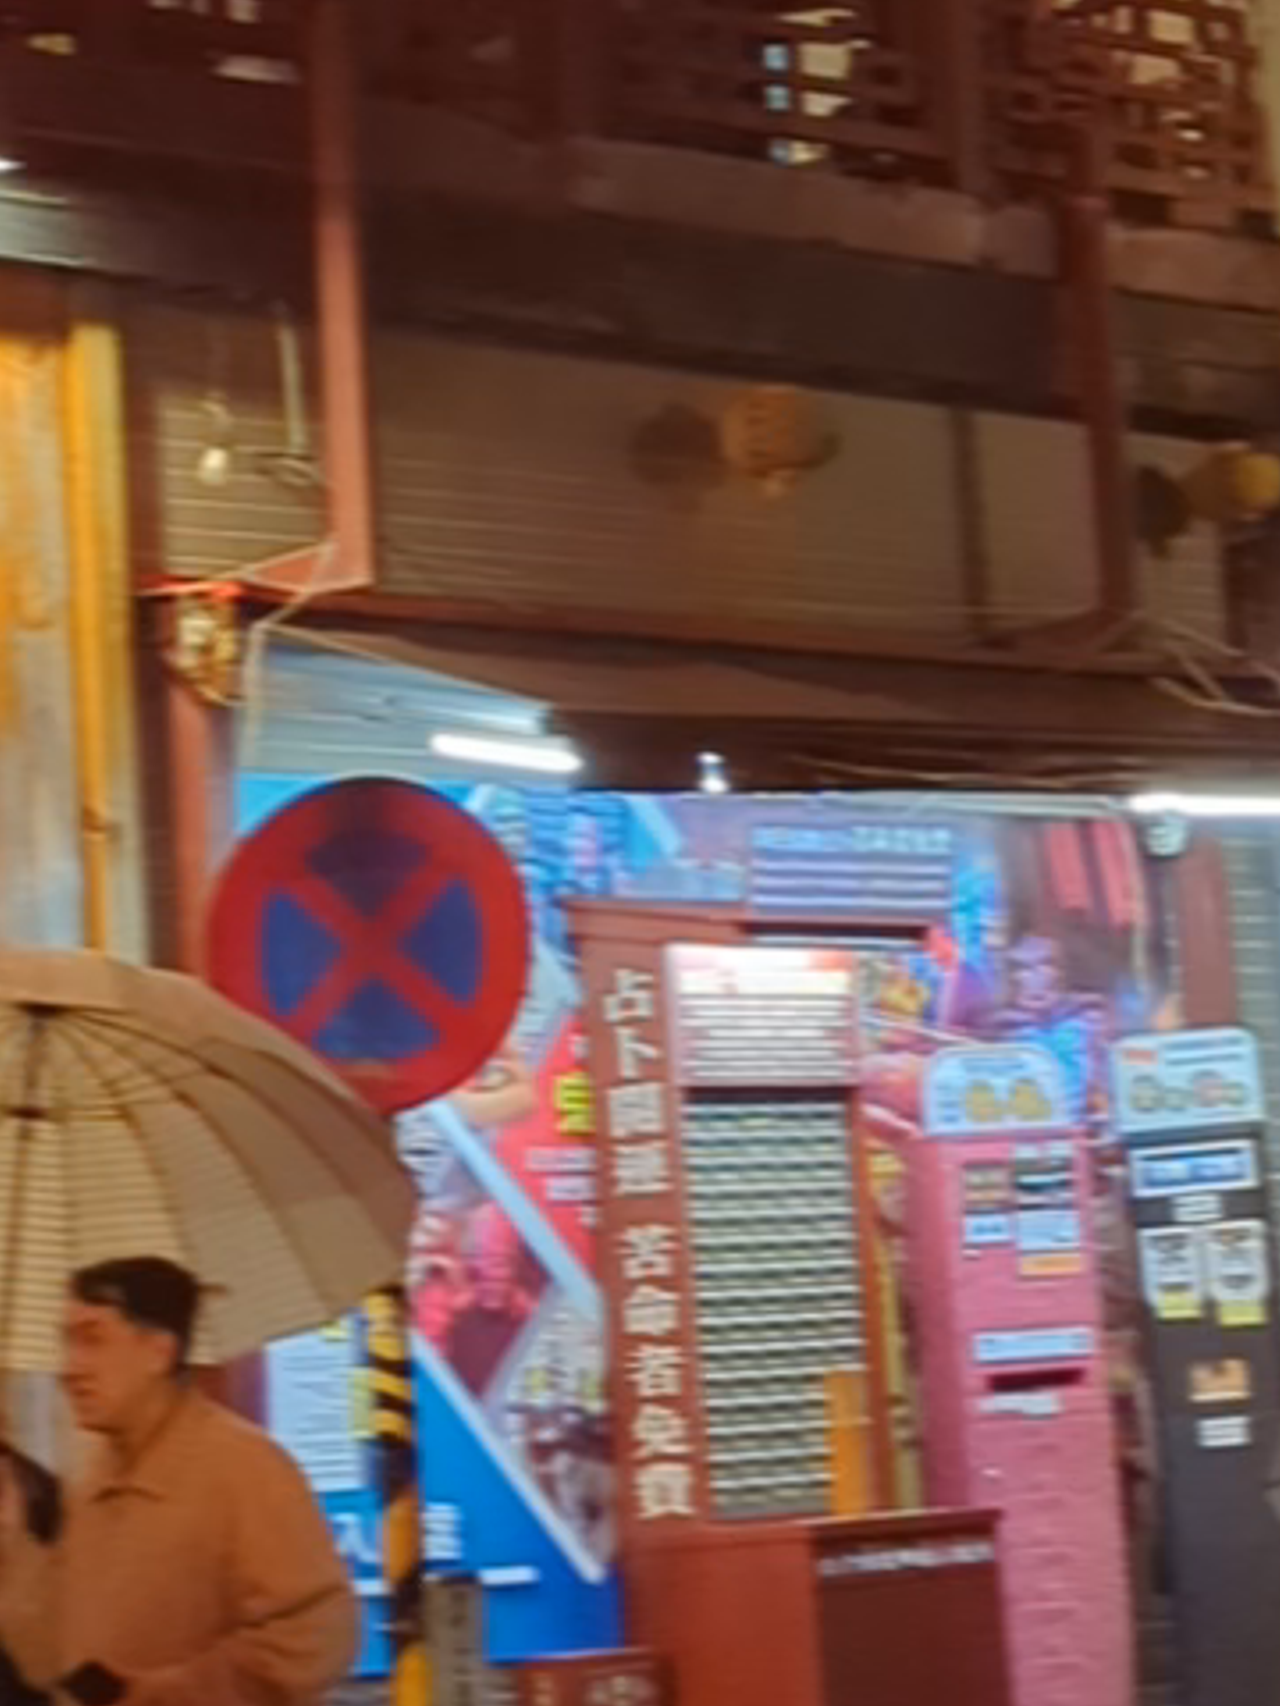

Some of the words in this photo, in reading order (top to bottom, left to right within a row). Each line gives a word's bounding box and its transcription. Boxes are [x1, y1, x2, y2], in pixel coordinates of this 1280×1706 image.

[620, 1223, 695, 1521] 苦命者免費
